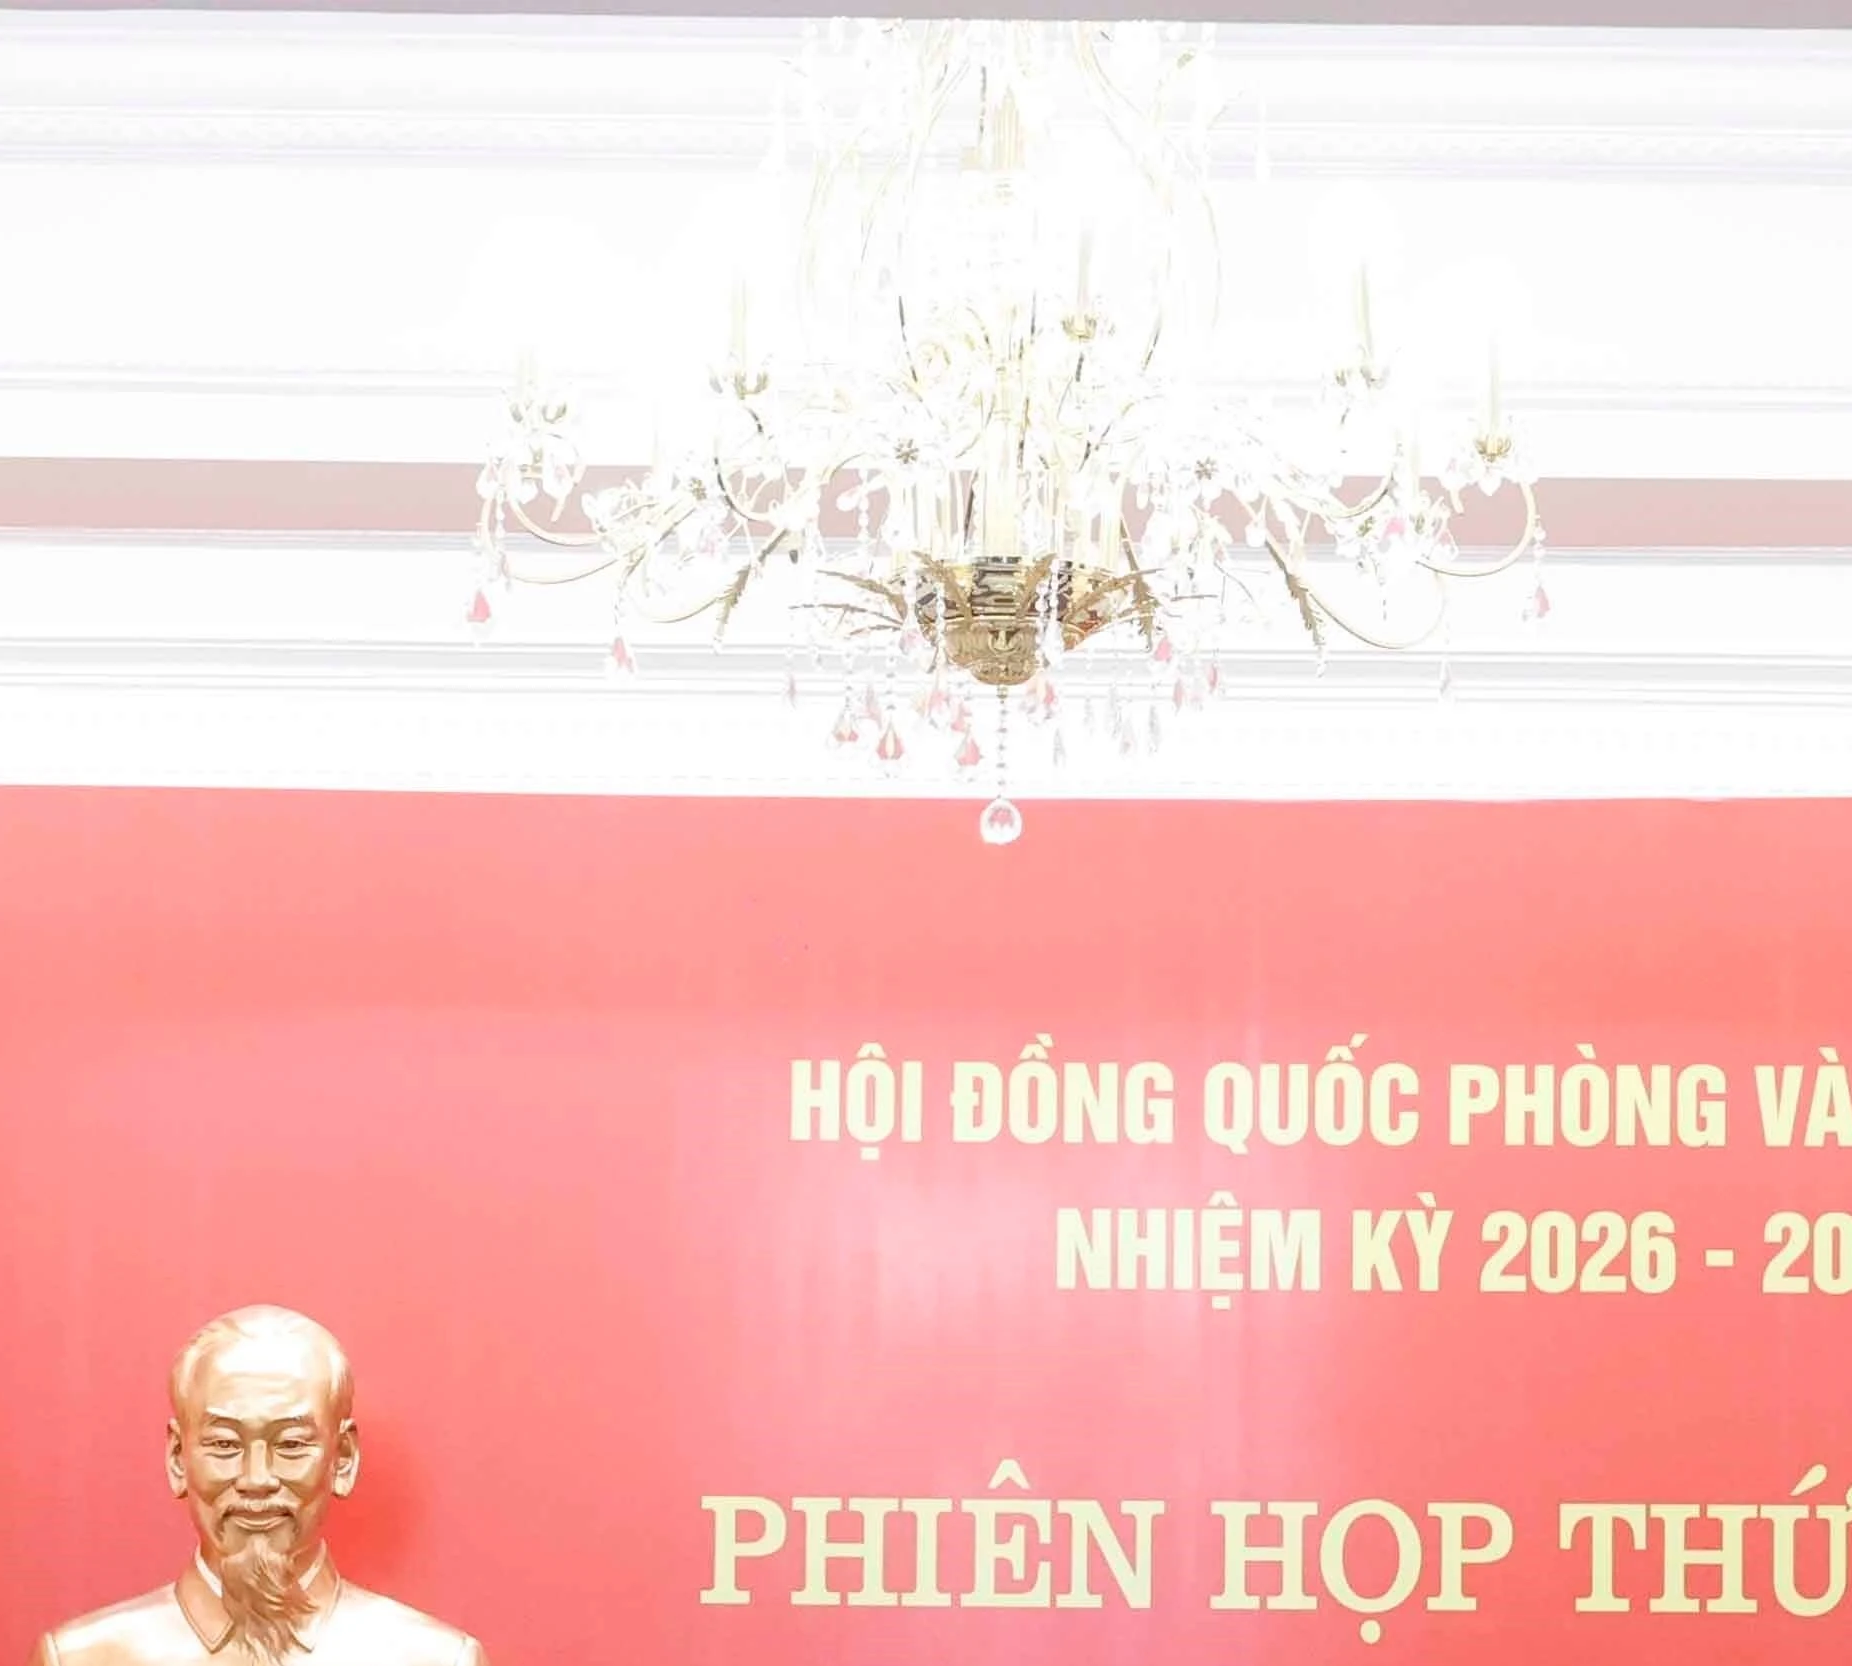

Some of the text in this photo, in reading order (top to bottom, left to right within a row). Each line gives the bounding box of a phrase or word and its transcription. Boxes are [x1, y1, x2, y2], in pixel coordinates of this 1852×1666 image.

[790, 1043, 924, 1158] HỘI
[951, 1033, 1174, 1146] ĐỒNG
[1204, 1031, 1420, 1153] QUỐC
[1448, 1043, 1727, 1148] PHÒNG
[1055, 1191, 1322, 1309] NHIỆM
[1351, 1191, 1454, 1292] KỲ
[1479, 1210, 1677, 1294] 2026
[1705, 1249, 1734, 1267] -
[699, 1457, 1166, 1609] PHIÊN
[1210, 1498, 1513, 1644] HỌP
